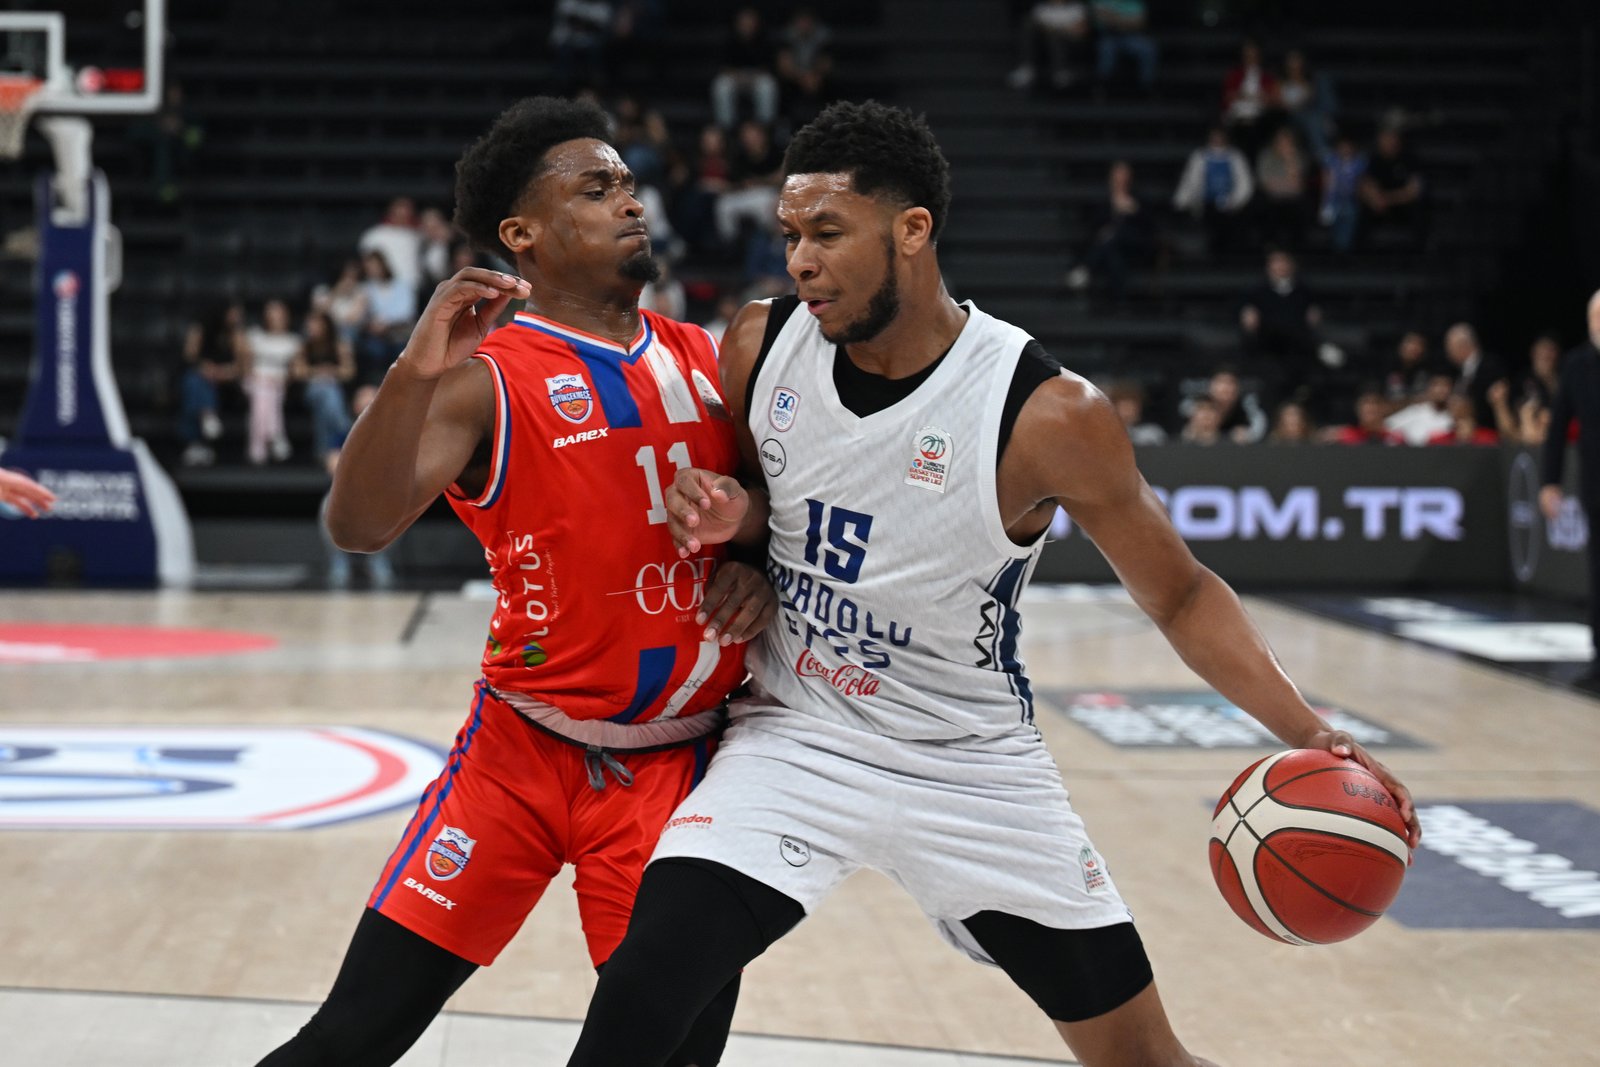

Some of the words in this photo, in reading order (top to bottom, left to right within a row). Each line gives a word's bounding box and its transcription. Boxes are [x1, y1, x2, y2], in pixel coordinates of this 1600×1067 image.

[804, 498, 874, 584] 15
[1153, 486, 1465, 541] OM.TR
[515, 534, 549, 637] LOTUS
